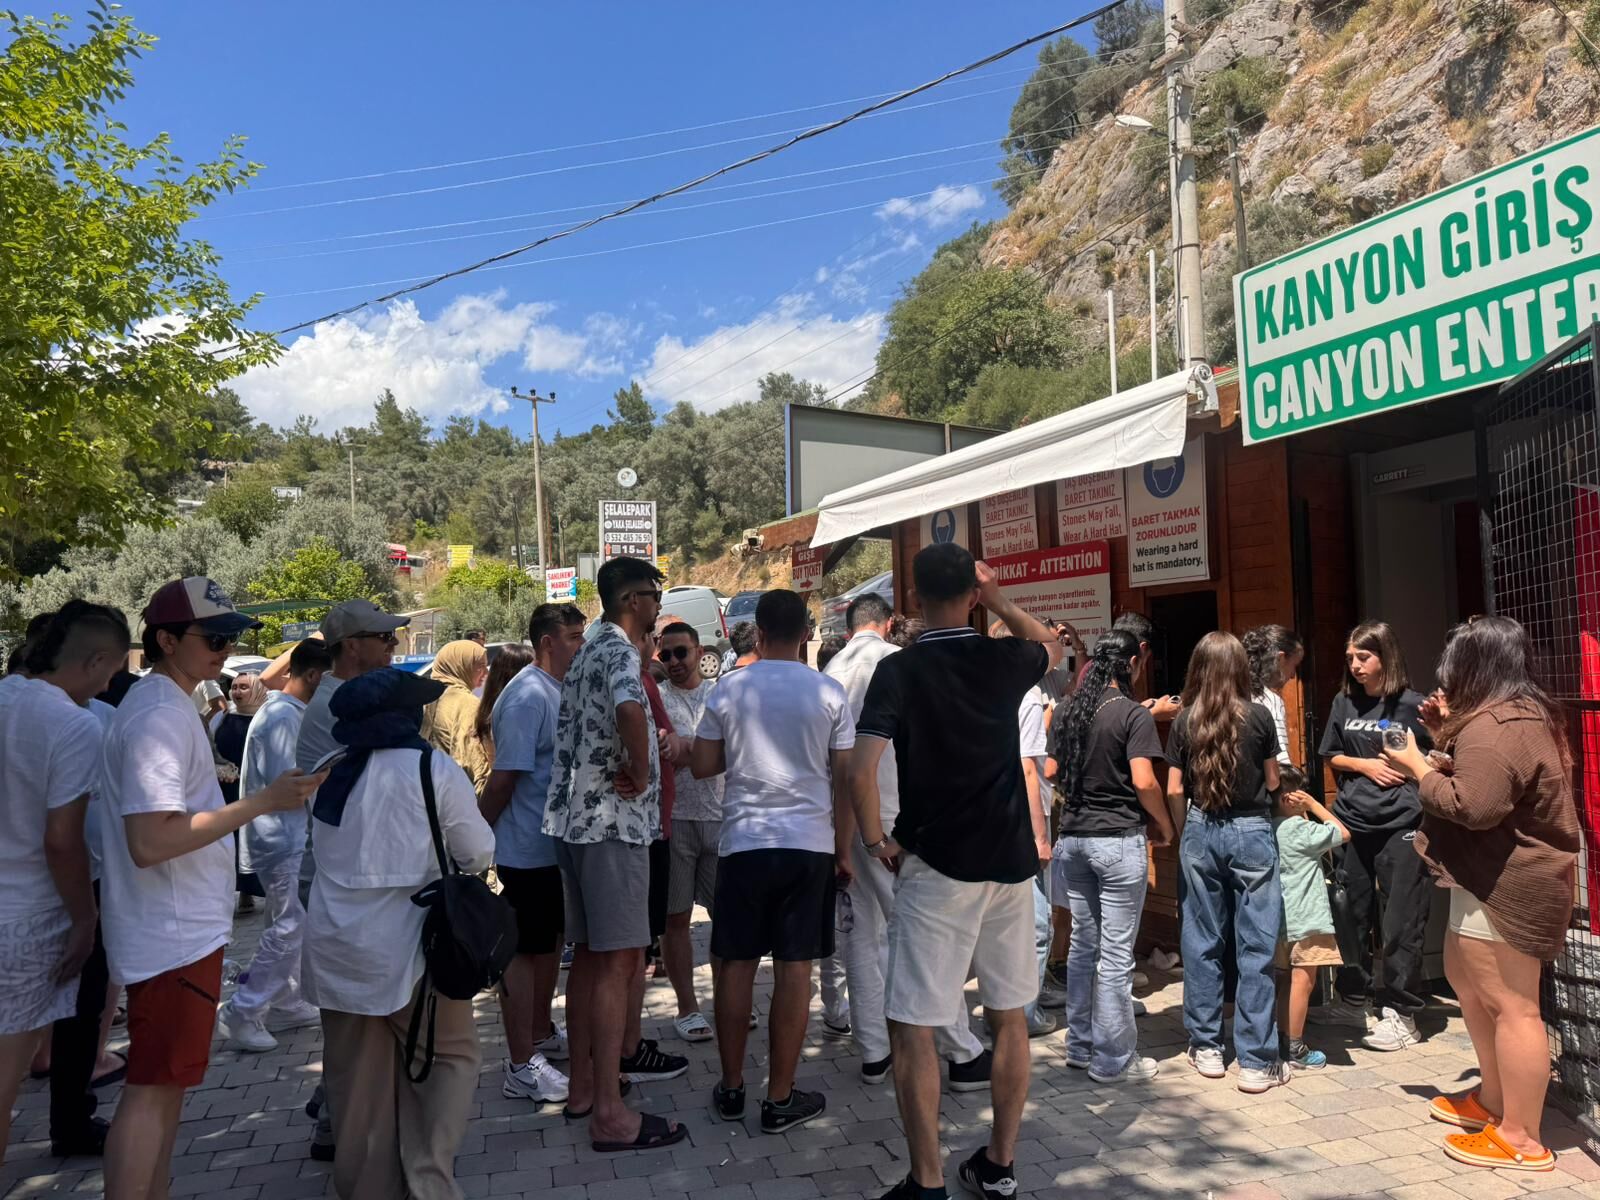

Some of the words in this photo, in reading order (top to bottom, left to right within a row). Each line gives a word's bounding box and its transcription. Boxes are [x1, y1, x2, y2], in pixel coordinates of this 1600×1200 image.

[1254, 227, 1426, 344] KANYON
[1439, 163, 1593, 278] GİRİŞ
[1253, 324, 1425, 430] CANYON
[1064, 490, 1087, 506] BARET
[1088, 484, 1116, 501] TAKINIZ
[604, 503, 651, 519] ŞELALEPARK
[986, 511, 1005, 523] BARET
[1062, 512, 1087, 527] Stones
[1088, 509, 1103, 523] May
[1104, 504, 1121, 519] Fall,
[1132, 513, 1160, 527] BARET
[1162, 506, 1201, 521] TAKMAK
[984, 529, 1005, 542] Stones
[1005, 525, 1019, 538] May
[1063, 531, 1081, 543] Wear
[1083, 529, 1089, 539] A
[1090, 526, 1108, 540] Hard
[1109, 524, 1122, 537] Hat
[1135, 522, 1197, 541] ZORUNLUDUR
[622, 545, 635, 553] 15
[986, 545, 1001, 557] Wear
[1002, 543, 1007, 552] A
[1007, 540, 1022, 553] Hard
[1023, 538, 1035, 550] Hat
[1136, 544, 1170, 557] Wearing
[1171, 545, 1177, 553] a
[1178, 539, 1198, 552] hard
[793, 566, 803, 580] BUY
[804, 562, 821, 578] TICKET
[1132, 562, 1145, 573] hat
[1147, 562, 1154, 571] is
[1155, 556, 1203, 570] mandatory.
[1064, 600, 1080, 610] kadar
